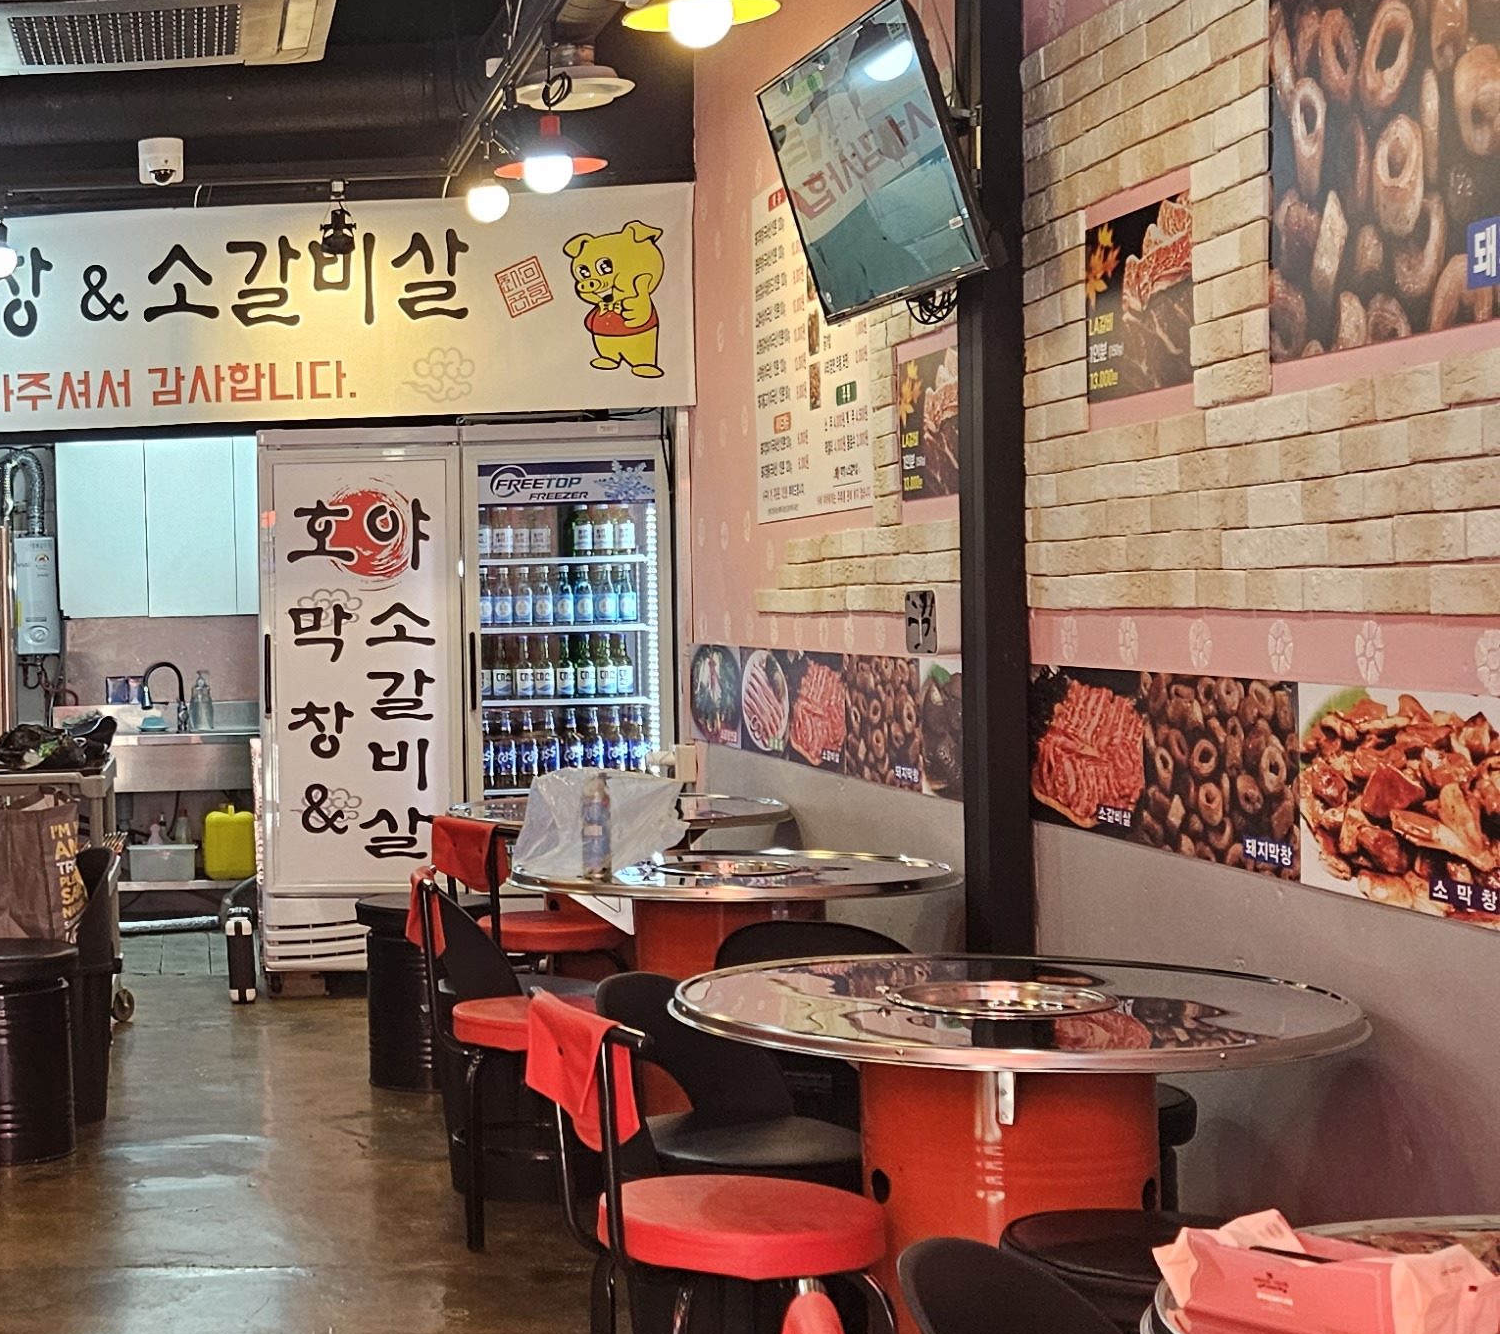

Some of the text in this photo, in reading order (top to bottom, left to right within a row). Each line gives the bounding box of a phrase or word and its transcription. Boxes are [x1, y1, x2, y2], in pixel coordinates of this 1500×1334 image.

[1473, 222, 1500, 278] 돼
[79, 263, 129, 323] &
[143, 228, 471, 327] 소갈비살
[148, 359, 357, 408] 감사합니다.
[495, 477, 582, 493] FREETOP
[529, 491, 589, 501] FREEZER
[287, 497, 431, 571] 호야
[1097, 805, 1132, 828] 소갈비살
[1244, 838, 1293, 867] 돼지막창
